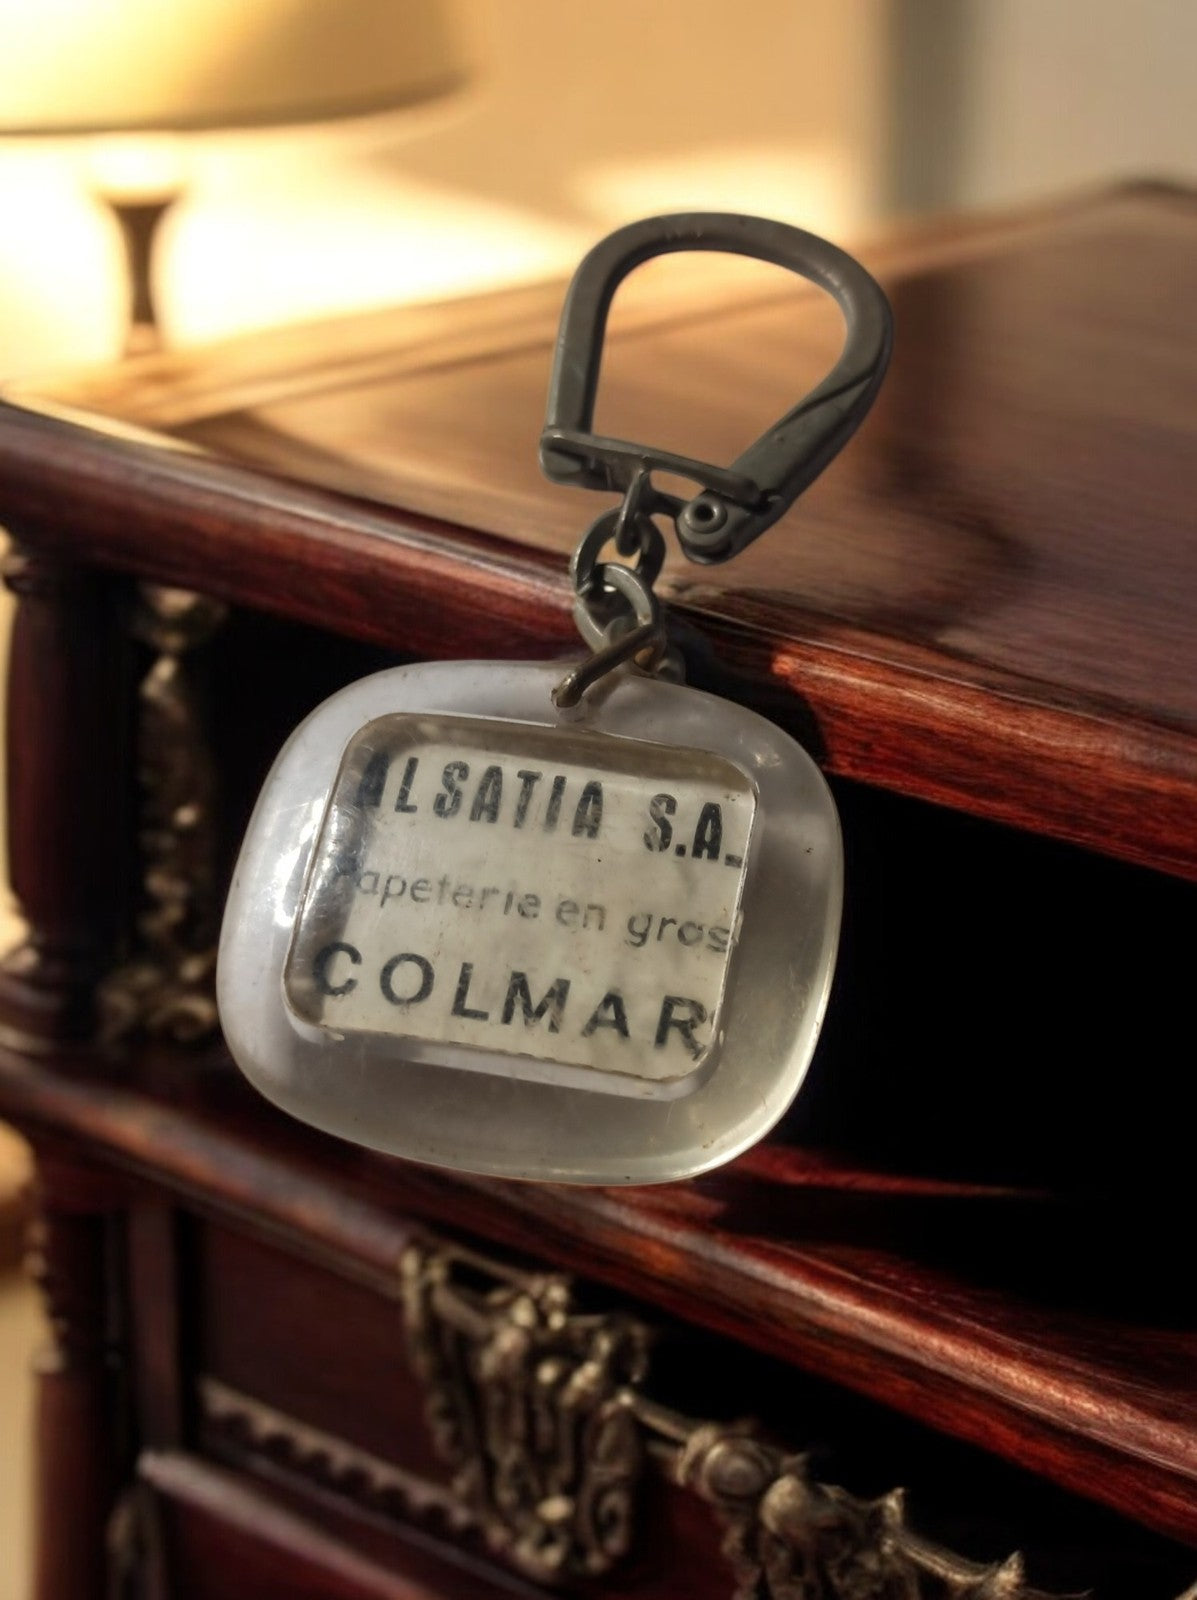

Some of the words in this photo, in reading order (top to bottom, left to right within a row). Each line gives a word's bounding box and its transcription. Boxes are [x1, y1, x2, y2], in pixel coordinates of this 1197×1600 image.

[334, 856, 541, 919] apeterie
[554, 901, 606, 931] en
[624, 910, 732, 954] gros
[312, 941, 706, 1061] COLMAR
